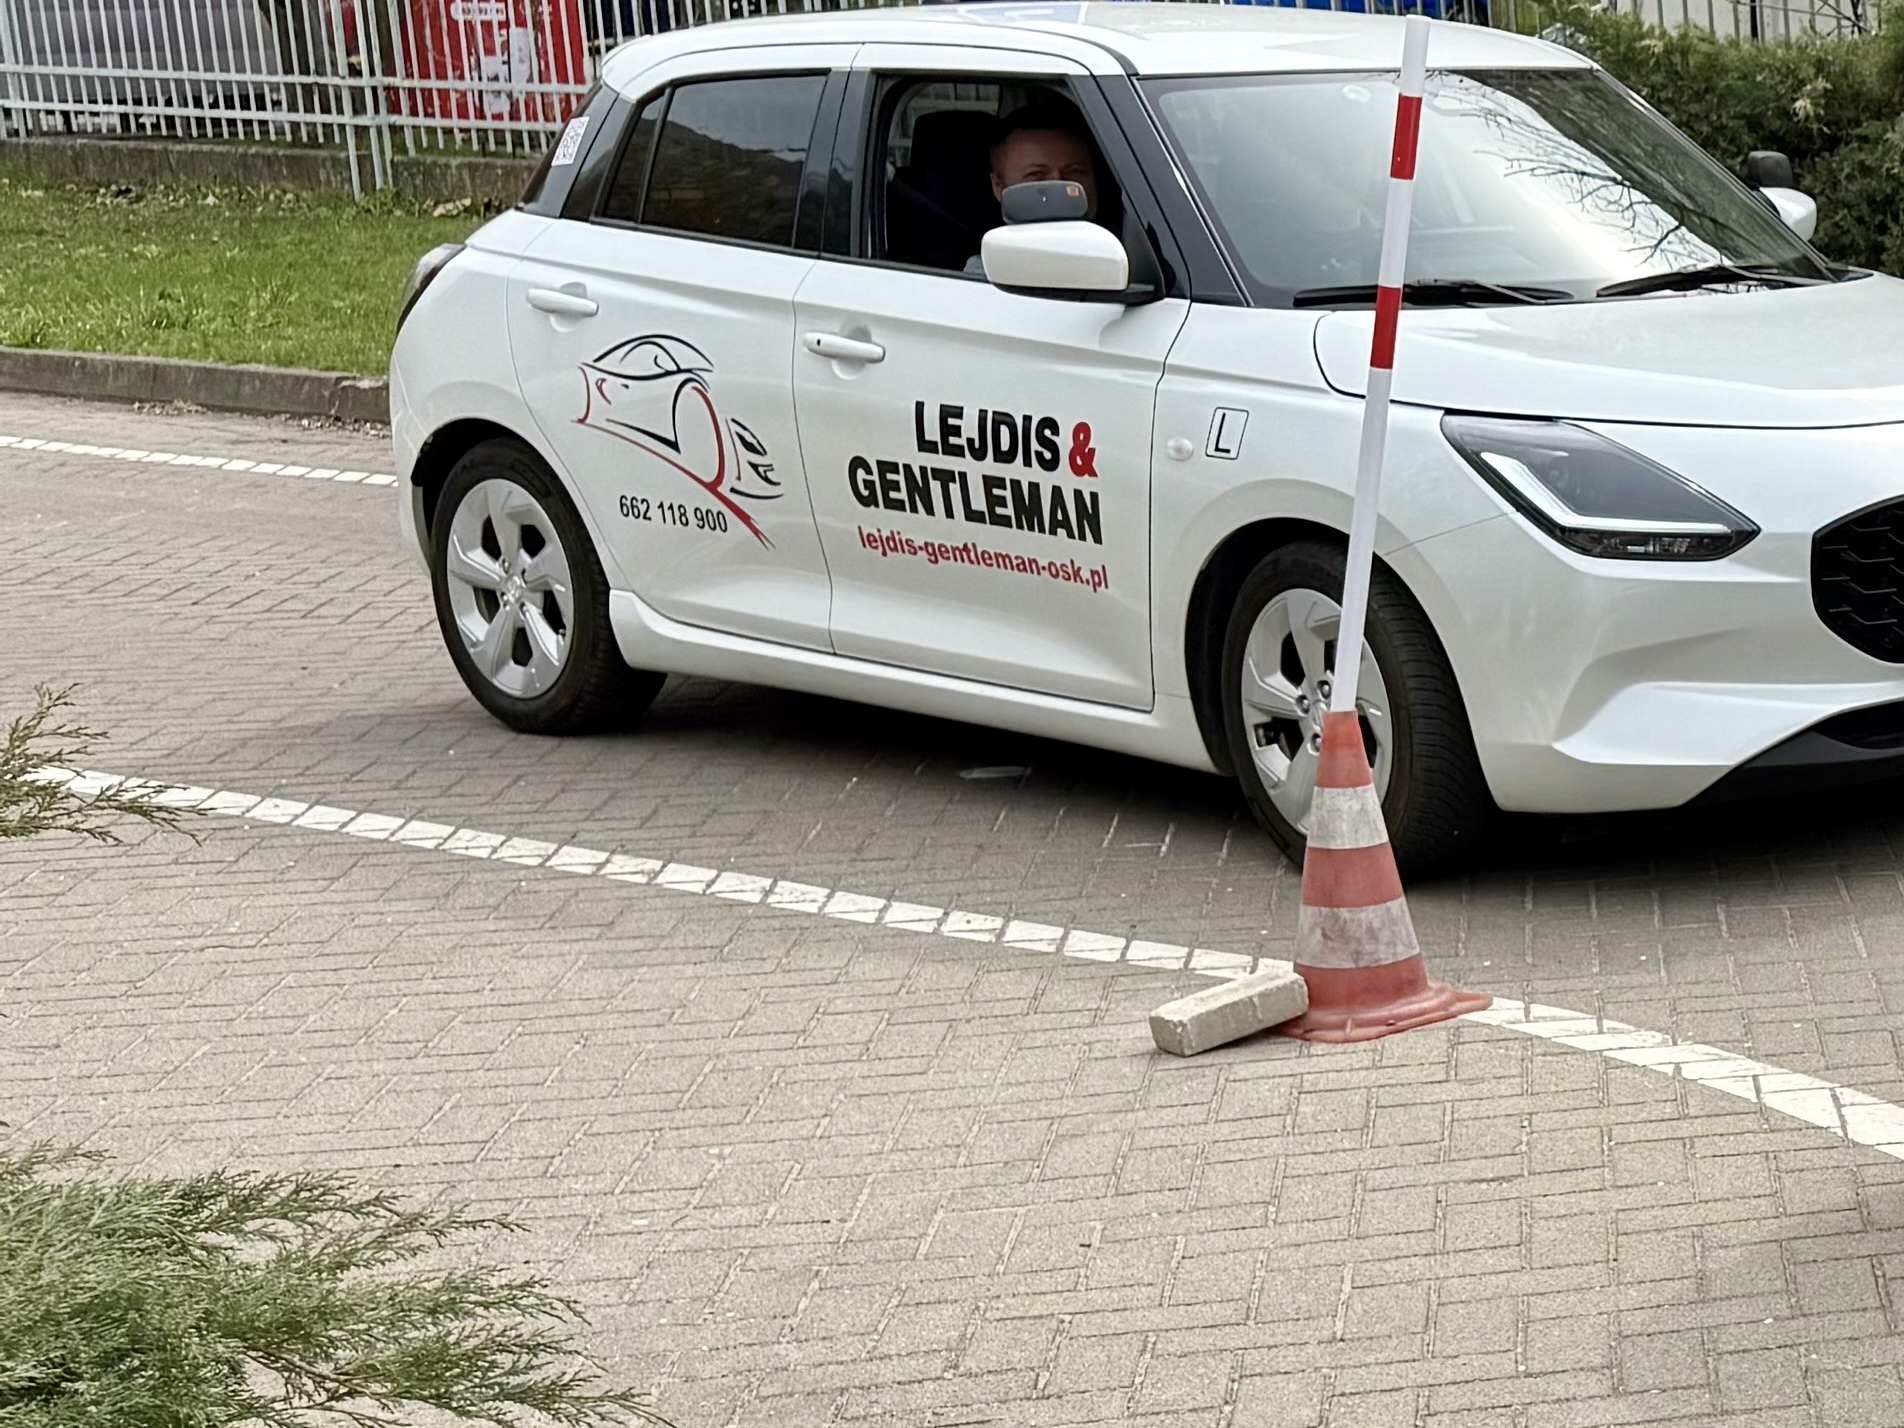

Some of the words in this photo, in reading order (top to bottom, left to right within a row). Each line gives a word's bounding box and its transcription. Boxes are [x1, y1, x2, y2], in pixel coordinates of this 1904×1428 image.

[914, 400, 1061, 473] LEJDIS
[1214, 412, 1231, 454] L
[619, 494, 652, 521] 662
[657, 500, 690, 527] 118
[693, 506, 728, 533] 900
[847, 455, 1103, 546] GENTLEMAN
[858, 525, 1109, 593] lejdis-gentleman-osk.pl
